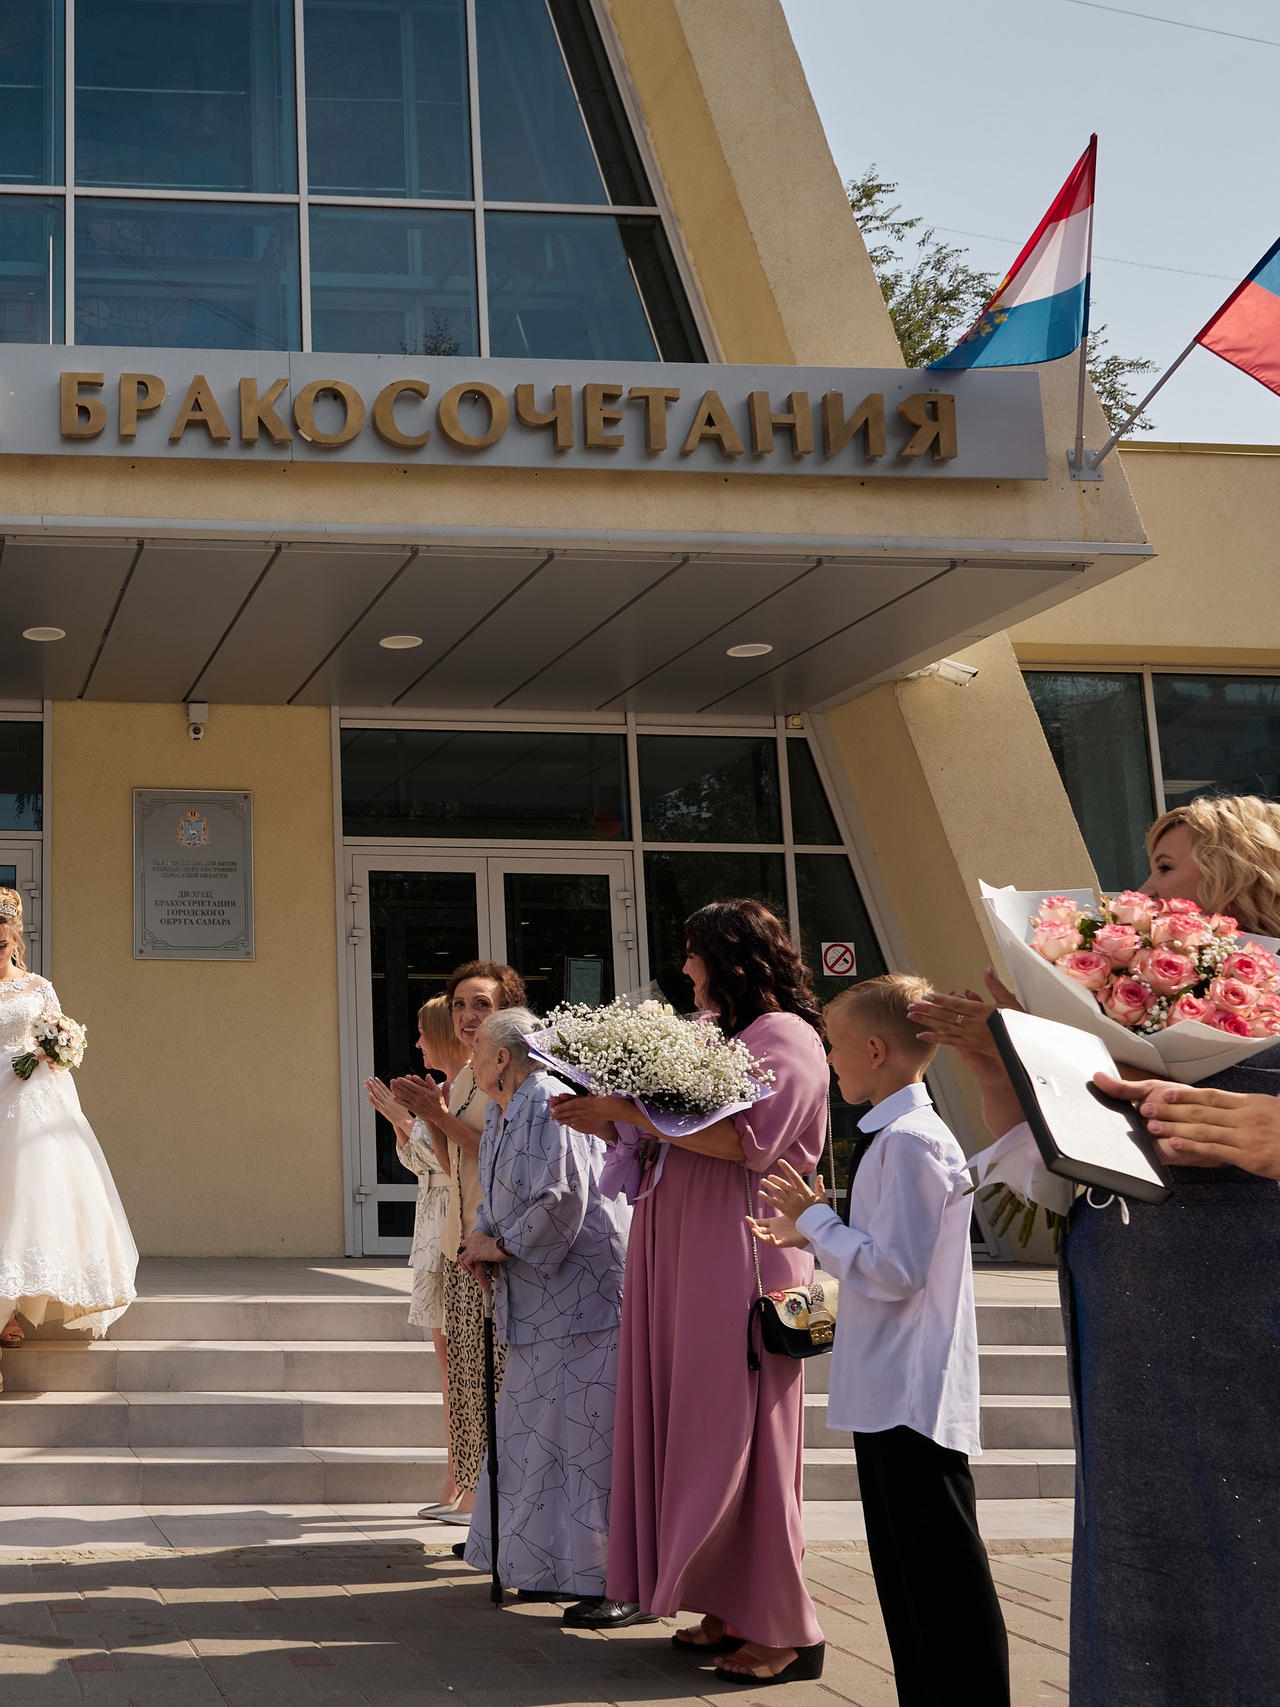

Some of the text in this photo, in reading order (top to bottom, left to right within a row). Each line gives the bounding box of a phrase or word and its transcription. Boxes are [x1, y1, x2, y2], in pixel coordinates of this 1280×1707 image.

[59, 371, 958, 461] БРАКОСОЧЕТАНИЯ
[177, 890, 213, 898] ДВОРЕЦ
[154, 899, 236, 907] БРАКОСОЧЕТАНИЯ
[166, 909, 225, 917] ГОРОДСКОГО
